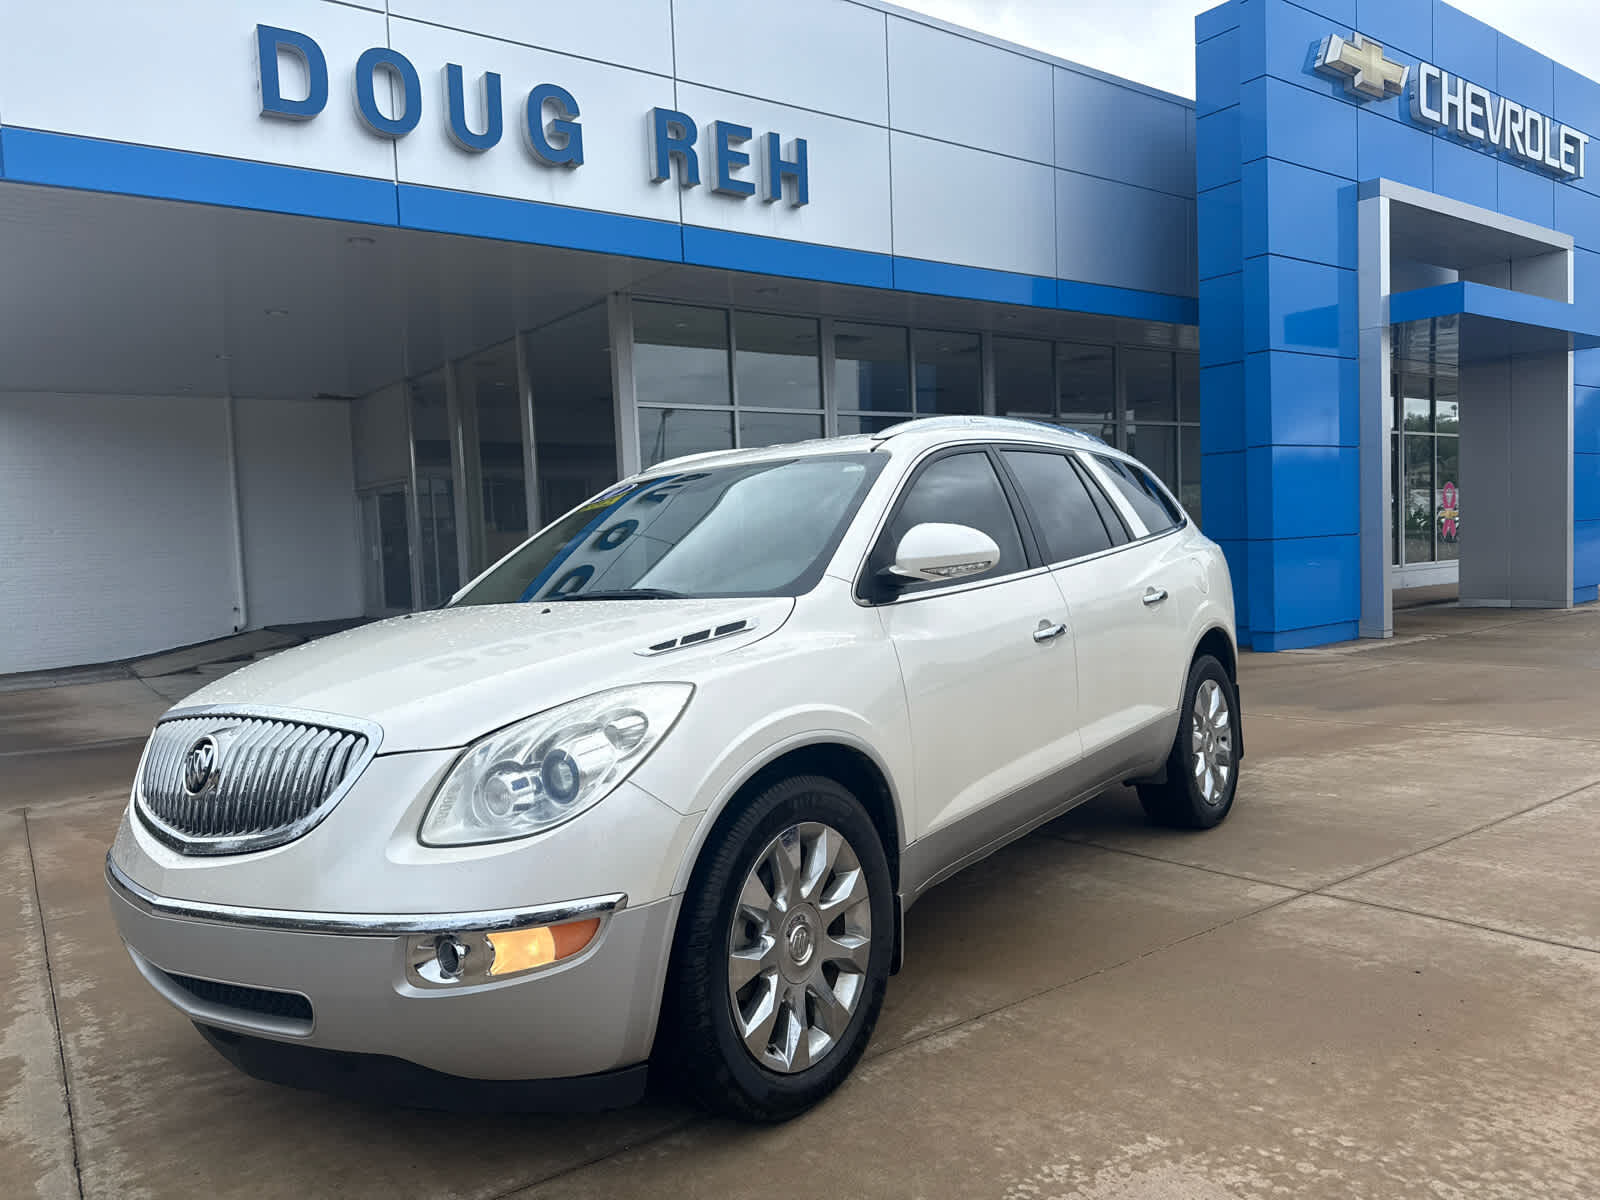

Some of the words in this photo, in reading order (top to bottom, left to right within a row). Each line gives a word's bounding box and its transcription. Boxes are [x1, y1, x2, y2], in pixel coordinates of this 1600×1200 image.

[256, 23, 584, 170] DOUG
[647, 106, 808, 208] REH
[1415, 61, 1590, 179] CHEVROLET
